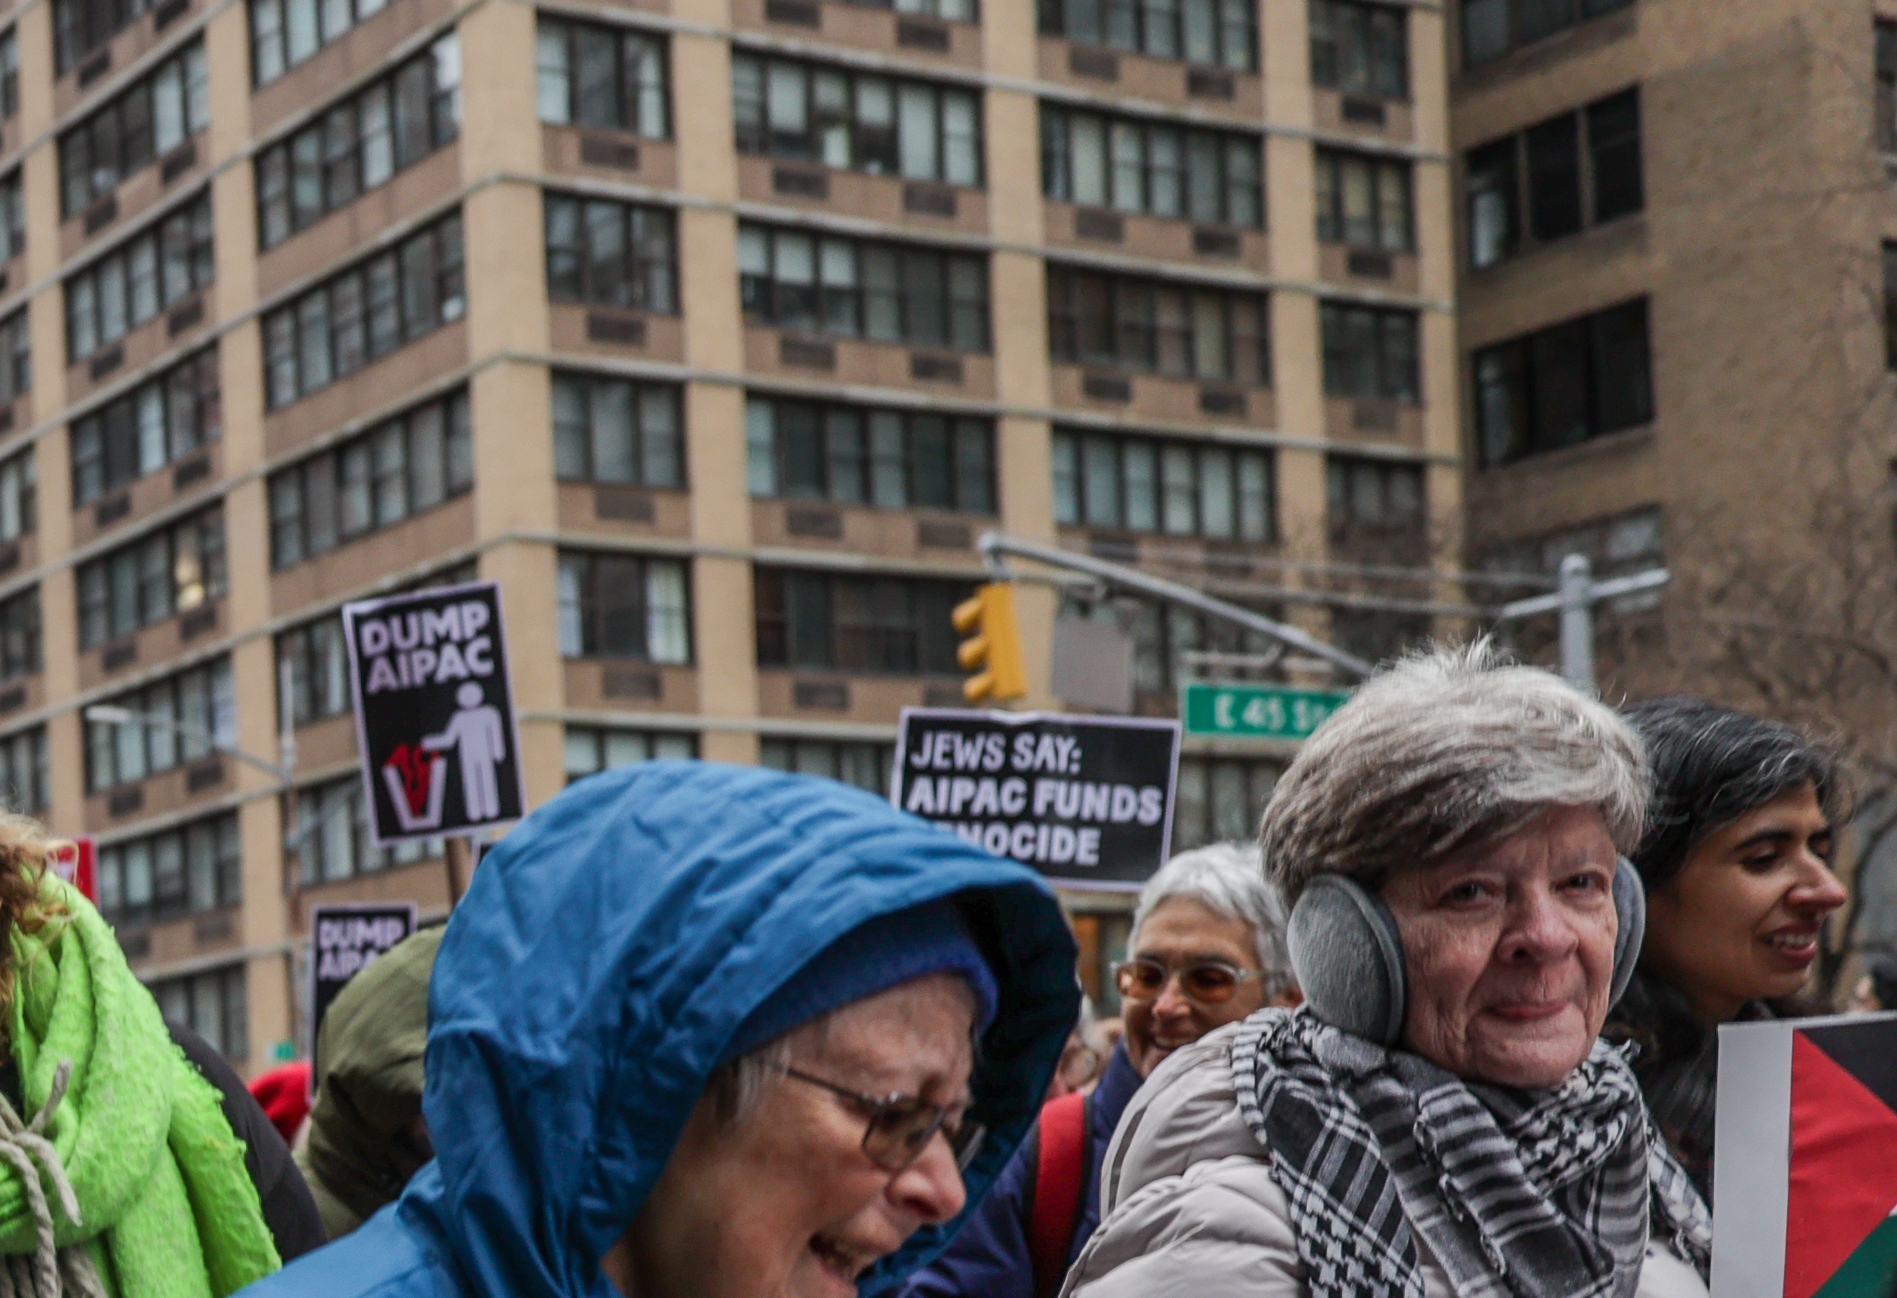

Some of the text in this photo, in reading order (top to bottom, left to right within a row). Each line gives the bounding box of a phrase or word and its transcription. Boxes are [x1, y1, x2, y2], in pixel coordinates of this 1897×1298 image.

[360, 600, 491, 657] DUMP
[366, 635, 495, 695] AIPAC
[1214, 693, 1237, 729] E
[1241, 697, 1286, 731] 45
[909, 730, 1082, 775] JEWS SAY:
[906, 774, 1164, 827] AIPAC FUNDS
[935, 820, 1101, 867] NOCIDE
[319, 917, 405, 949] DUMP
